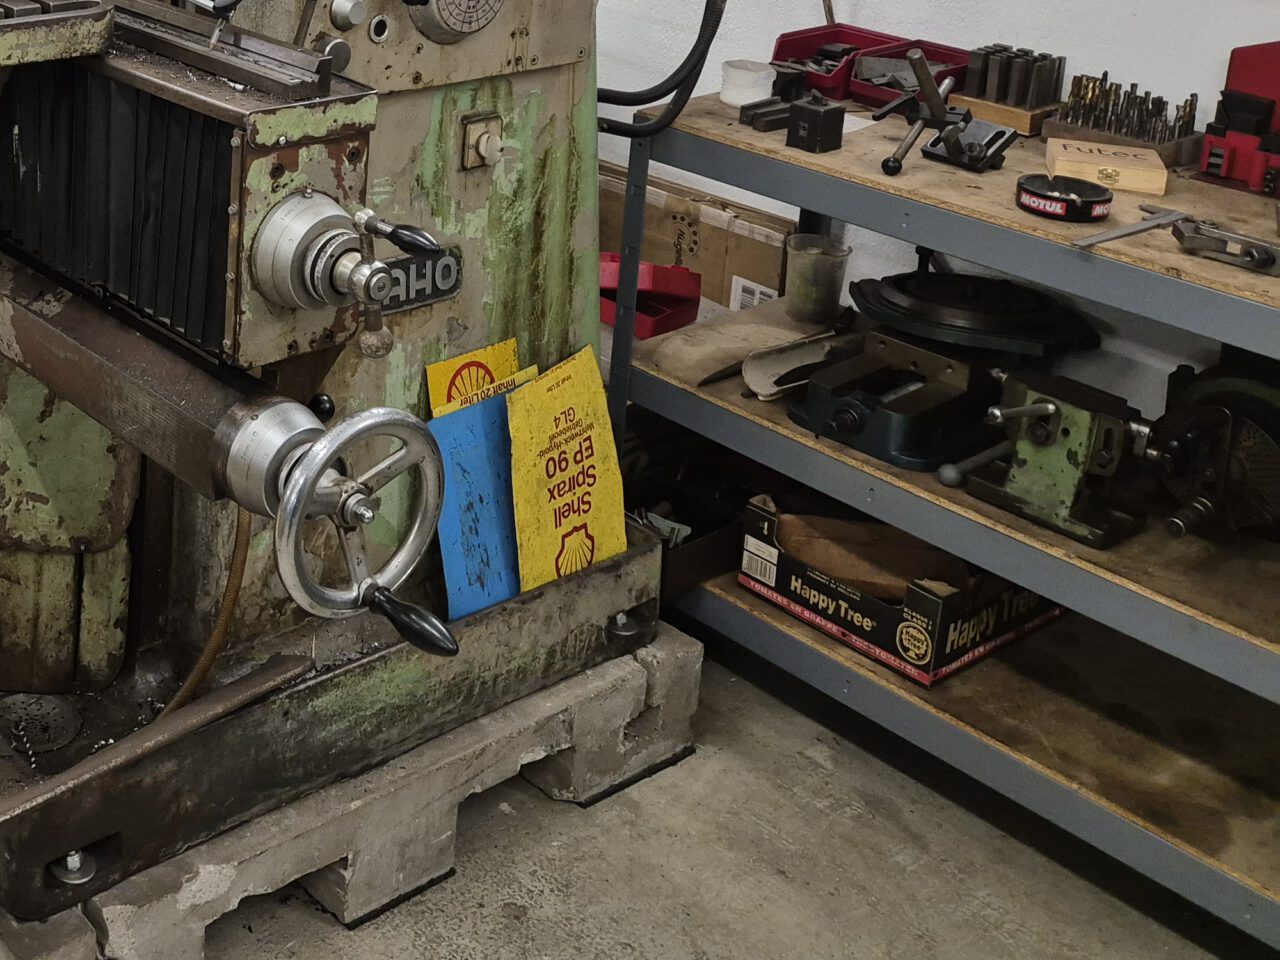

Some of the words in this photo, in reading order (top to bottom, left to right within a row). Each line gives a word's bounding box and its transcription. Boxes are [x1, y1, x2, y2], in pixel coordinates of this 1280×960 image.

[1021, 193, 1063, 214] MOTUL
[1093, 204, 1111, 215] MO
[383, 255, 458, 306] AHO
[459, 393, 480, 407] Liter
[480, 389, 492, 401] 20
[493, 378, 516, 397] Inhalt
[573, 434, 595, 465] EP
[545, 450, 569, 480] 90
[547, 464, 597, 503] Spirax
[553, 491, 592, 529] Shell
[790, 574, 837, 615] Happy
[905, 628, 925, 646] Happy
[945, 604, 999, 655] Happy
